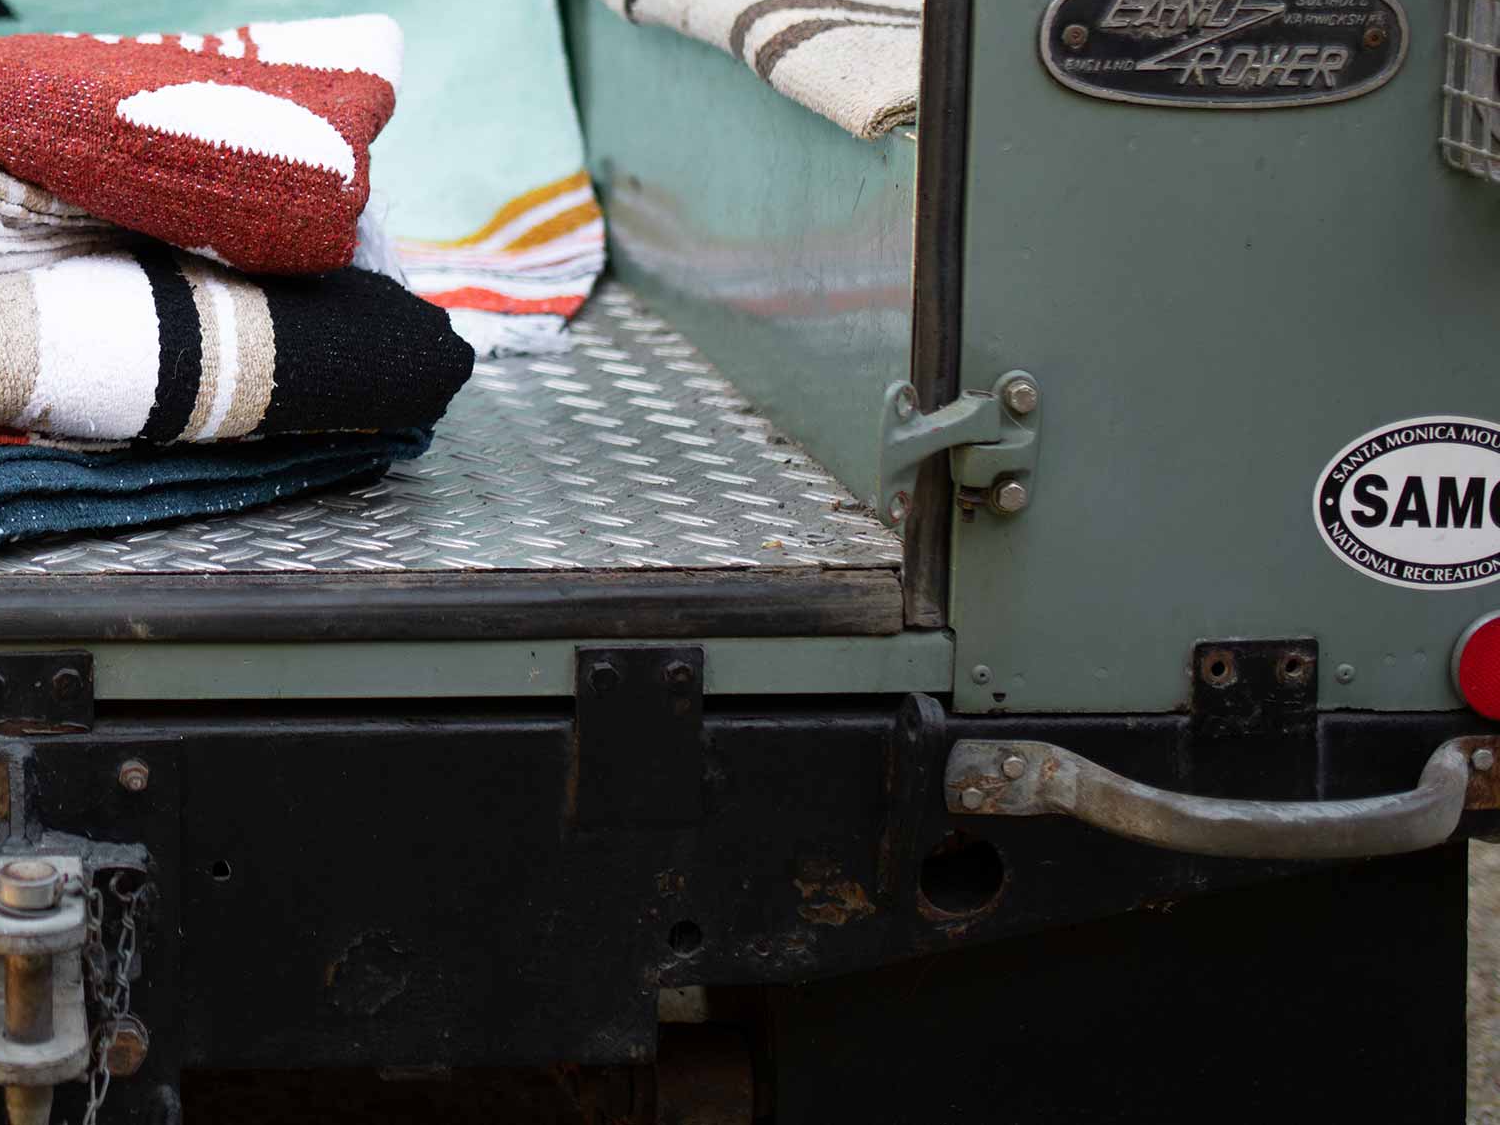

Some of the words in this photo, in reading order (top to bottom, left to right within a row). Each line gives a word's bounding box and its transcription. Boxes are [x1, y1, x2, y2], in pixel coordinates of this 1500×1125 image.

[1178, 46, 1349, 87] ROVER
[1331, 441, 1382, 483] SANTA
[1386, 425, 1457, 449] MONICA
[1351, 473, 1500, 530] SAM
[1327, 520, 1399, 577] NATIONAL
